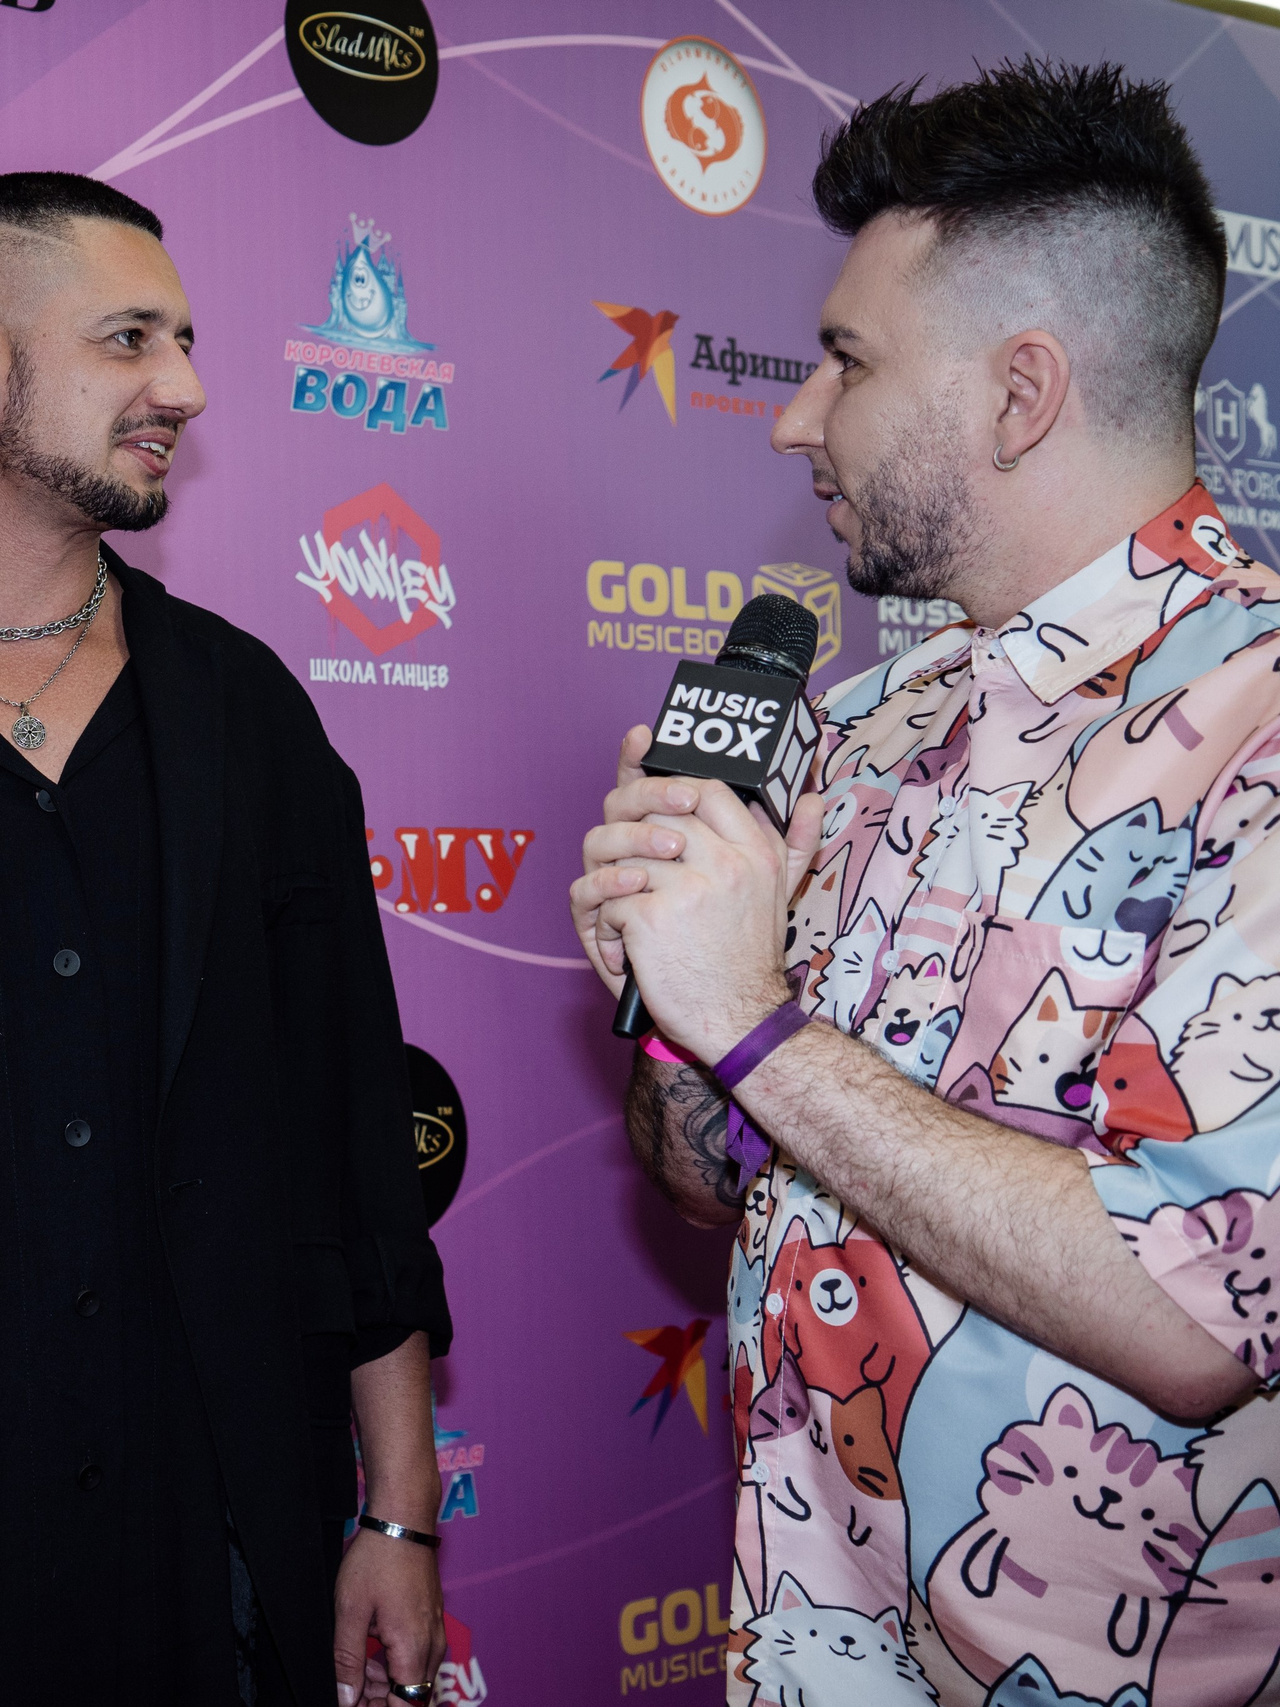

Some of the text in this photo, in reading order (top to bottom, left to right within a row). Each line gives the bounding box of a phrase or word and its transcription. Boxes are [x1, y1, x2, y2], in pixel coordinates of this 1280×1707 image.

[284, 340, 455, 384] КОРОЛЕВСКАЯ
[291, 364, 449, 435] ВОДА
[586, 560, 744, 623] GOLD
[587, 620, 729, 657] MUSICBO
[310, 658, 449, 691] ШКОЛА ТАНЦЕВ
[670, 683, 780, 724] MUSIC
[656, 710, 771, 762] BOX
